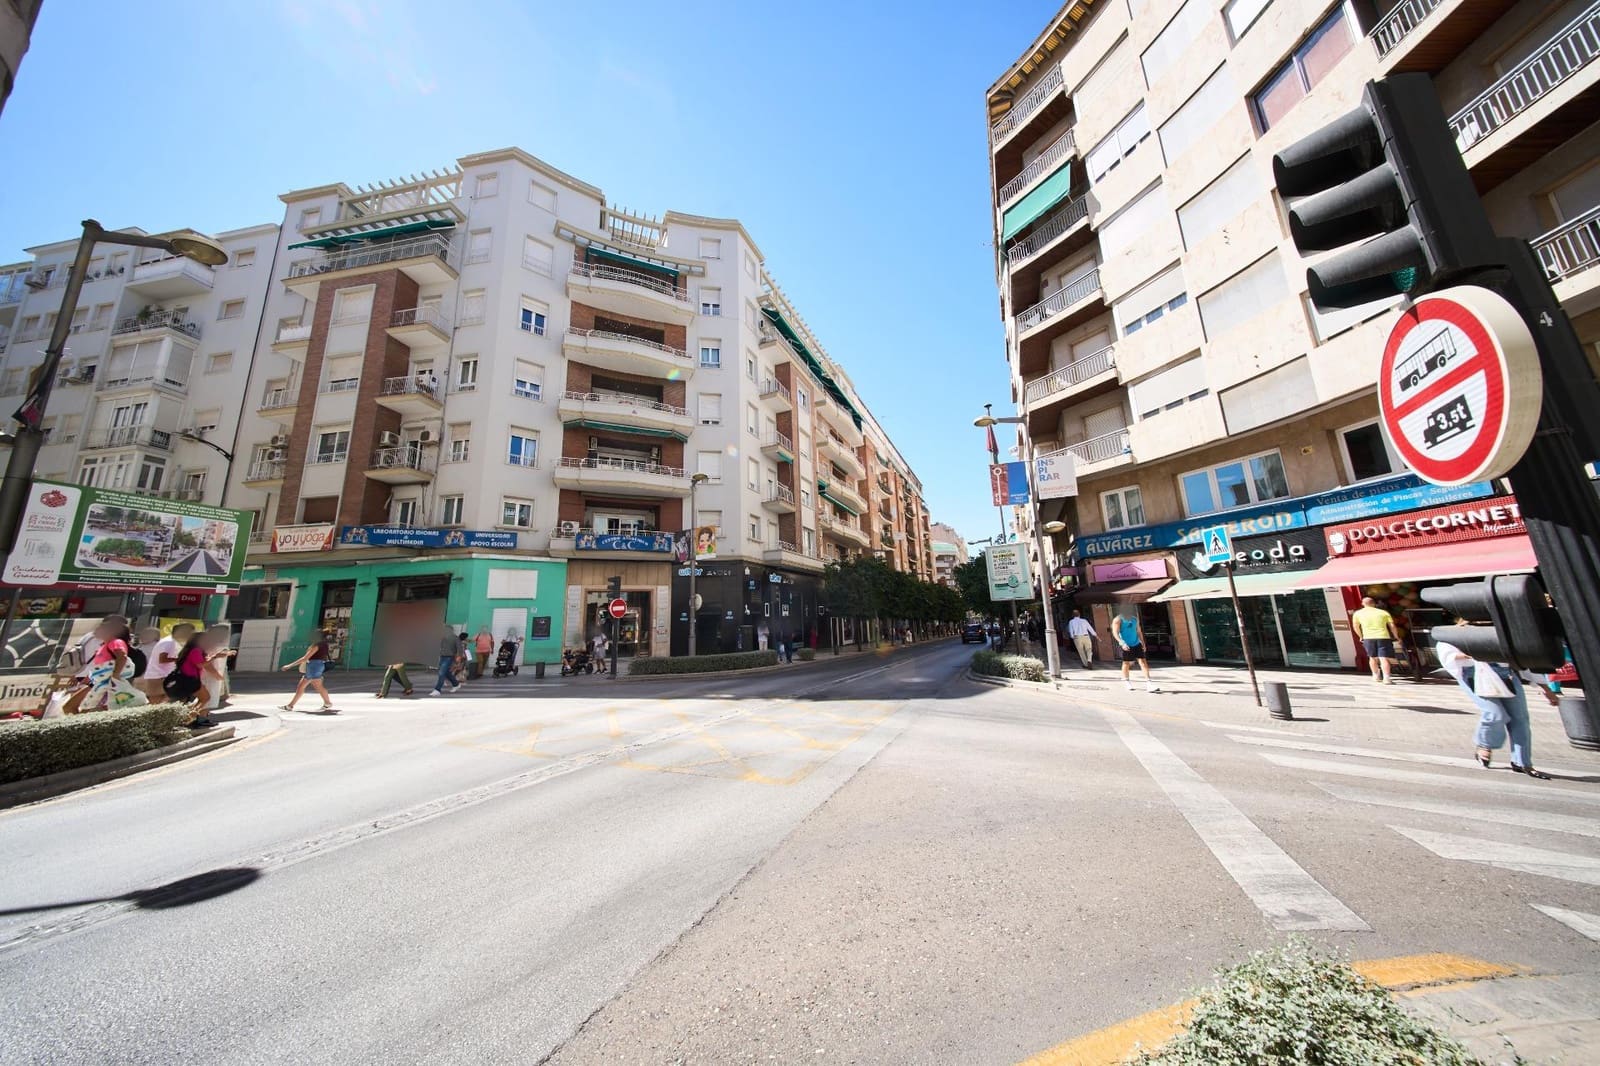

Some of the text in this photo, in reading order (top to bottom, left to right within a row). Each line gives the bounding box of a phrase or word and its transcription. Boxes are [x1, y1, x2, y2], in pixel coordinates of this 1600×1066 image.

[1540, 311, 1553, 327] 4
[1437, 403, 1467, 430] 3,5t
[1037, 459, 1055, 467] INS
[1039, 473, 1060, 482] RAR
[1316, 494, 1348, 505] Venta
[1351, 490, 1365, 499] de
[1369, 483, 1401, 497] pisos
[1405, 481, 1412, 489] y
[1392, 491, 1423, 502] Fincas
[1419, 491, 1473, 506] Alquileres
[373, 528, 414, 536] LABORATORIO
[1176, 511, 1292, 541] SAERON
[278, 534, 292, 546] yo
[300, 532, 325, 546] yoga
[386, 538, 424, 546] MULTIMEDIA
